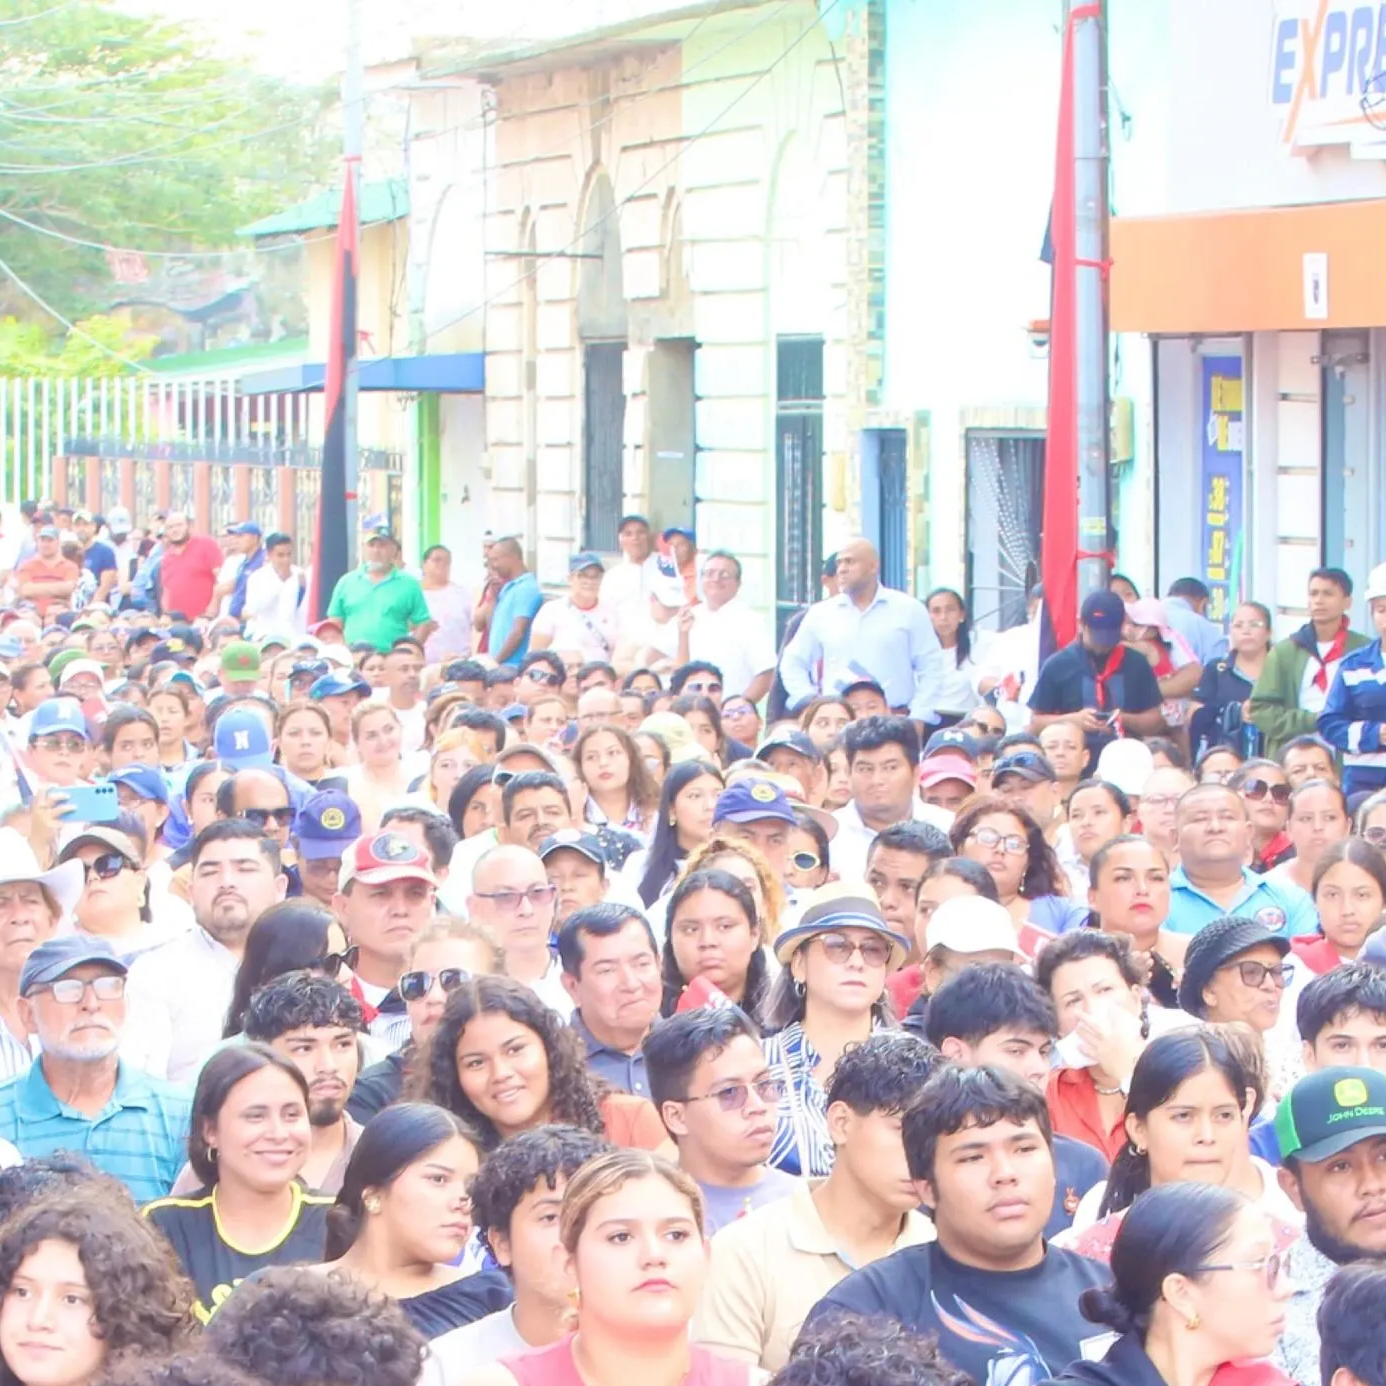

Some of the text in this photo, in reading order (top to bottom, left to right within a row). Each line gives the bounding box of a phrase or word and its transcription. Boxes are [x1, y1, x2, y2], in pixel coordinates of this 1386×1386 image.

[233, 730, 250, 752] N
[1326, 1105, 1386, 1125] JOHN DEERE
